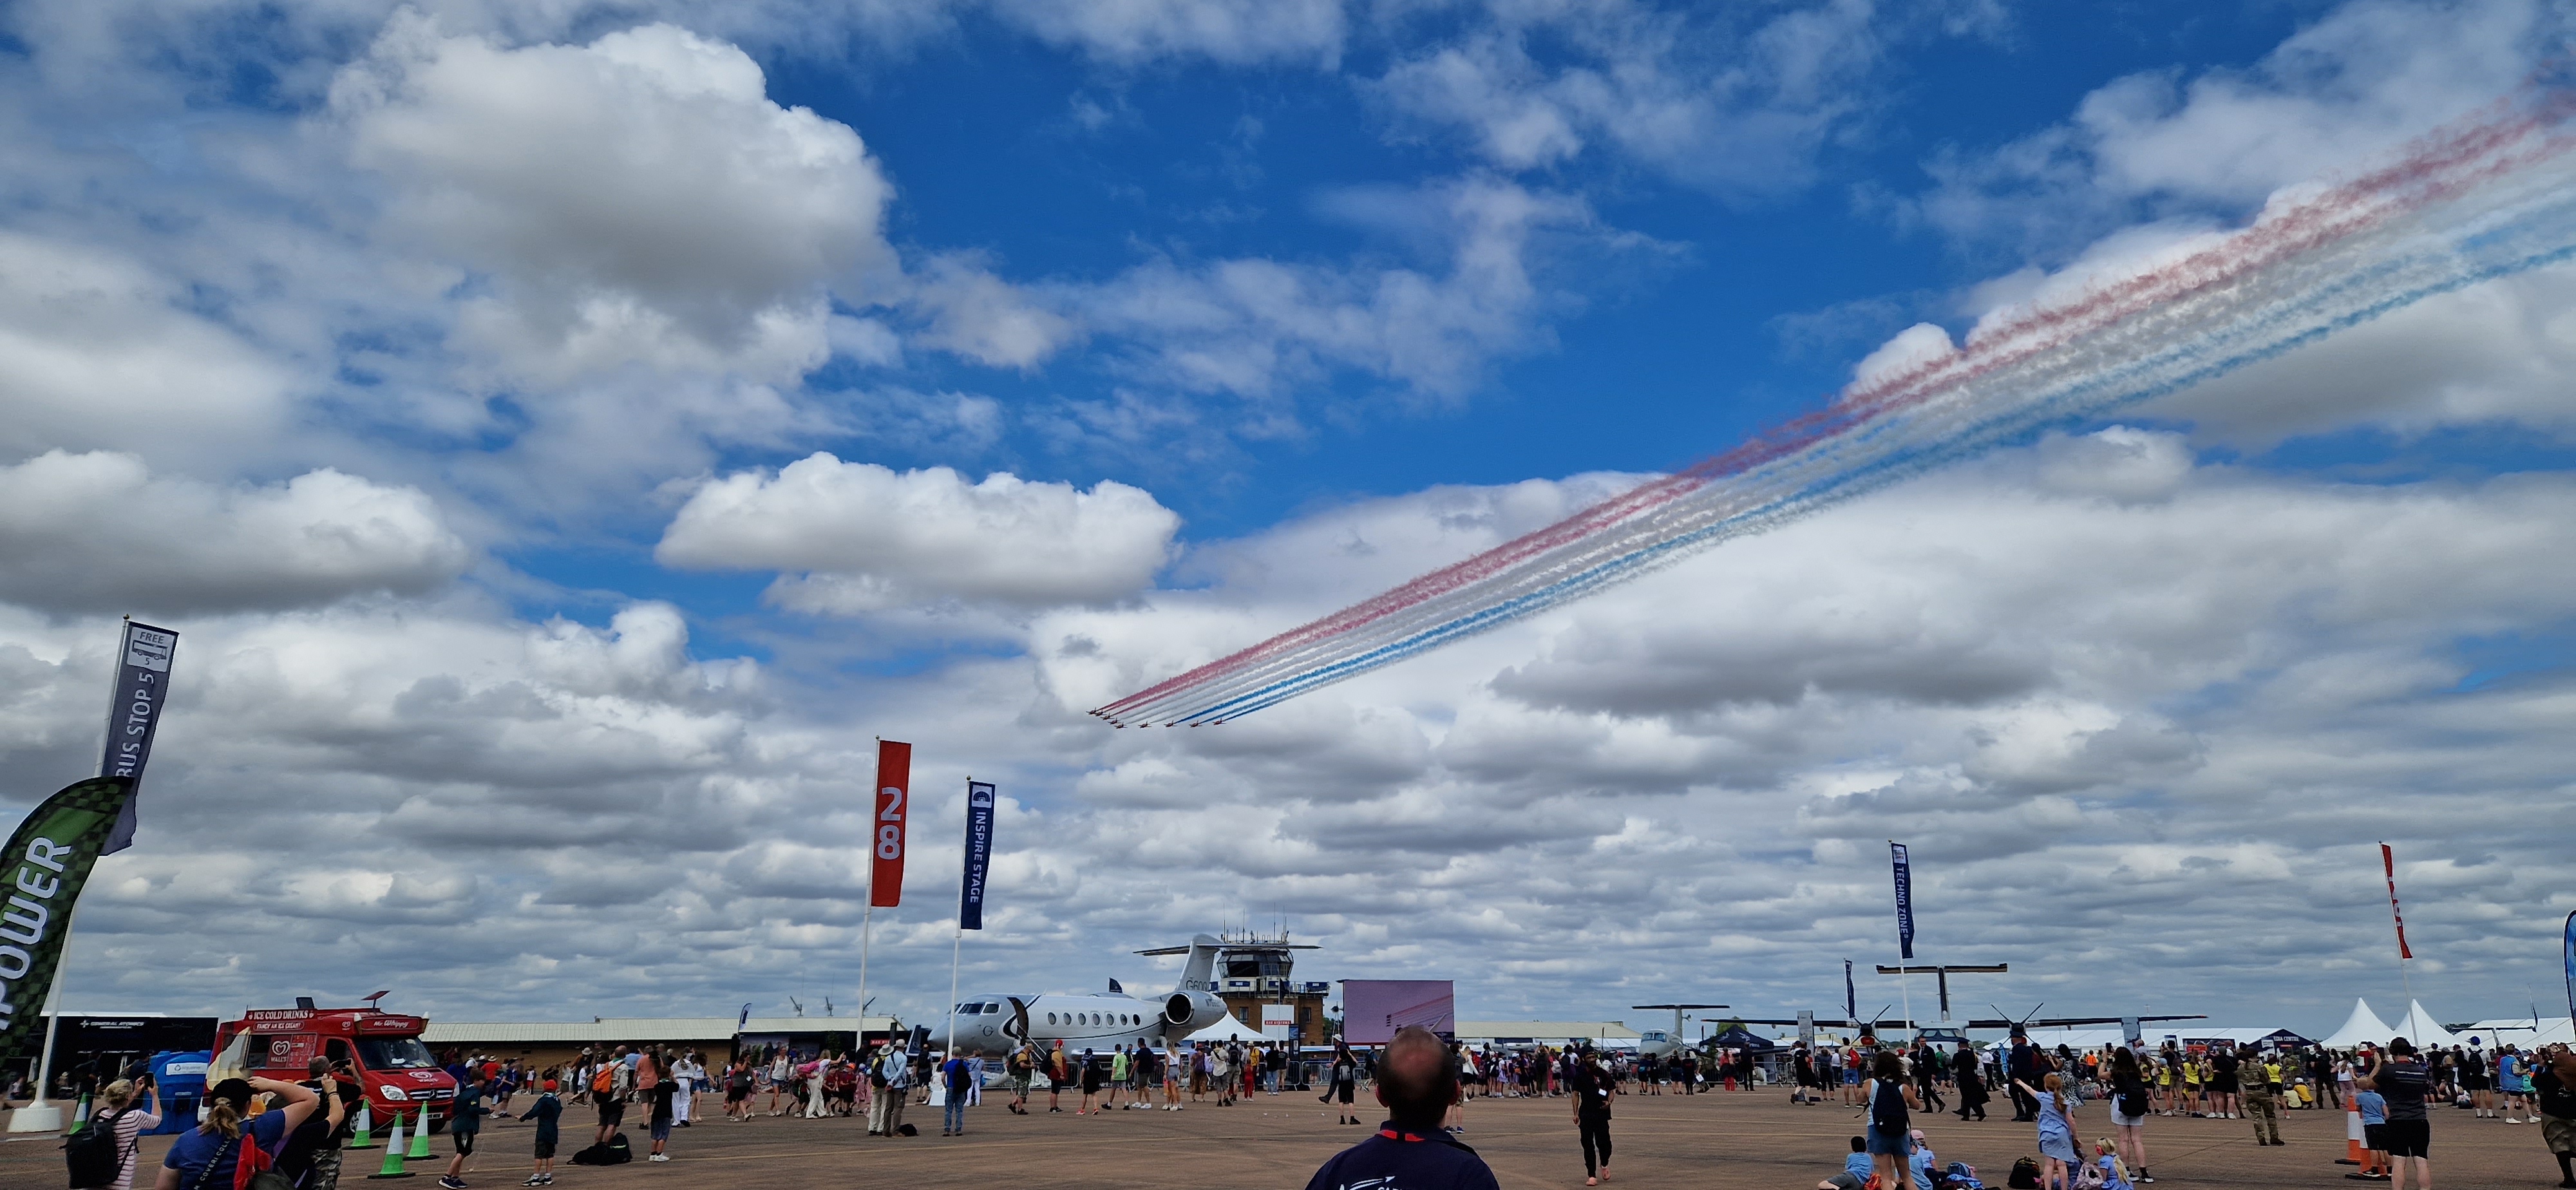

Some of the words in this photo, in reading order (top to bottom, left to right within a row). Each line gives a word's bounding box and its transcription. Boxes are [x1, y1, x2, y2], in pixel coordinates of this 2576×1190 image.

[139, 631, 164, 644] FREE
[144, 657, 150, 666] 5
[138, 672, 155, 685] 5
[126, 689, 153, 737] STOP
[877, 786, 902, 860] 28
[973, 811, 987, 862] INSPIRE
[970, 864, 982, 903] STAGE
[1896, 866, 1906, 905] TECHNO
[254, 1011, 265, 1020] ICE
[265, 1010, 282, 1019] COLD
[283, 1010, 308, 1019] DRINKS
[384, 1019, 409, 1028] Whippy
[200, 1157, 218, 1181] COVERI
